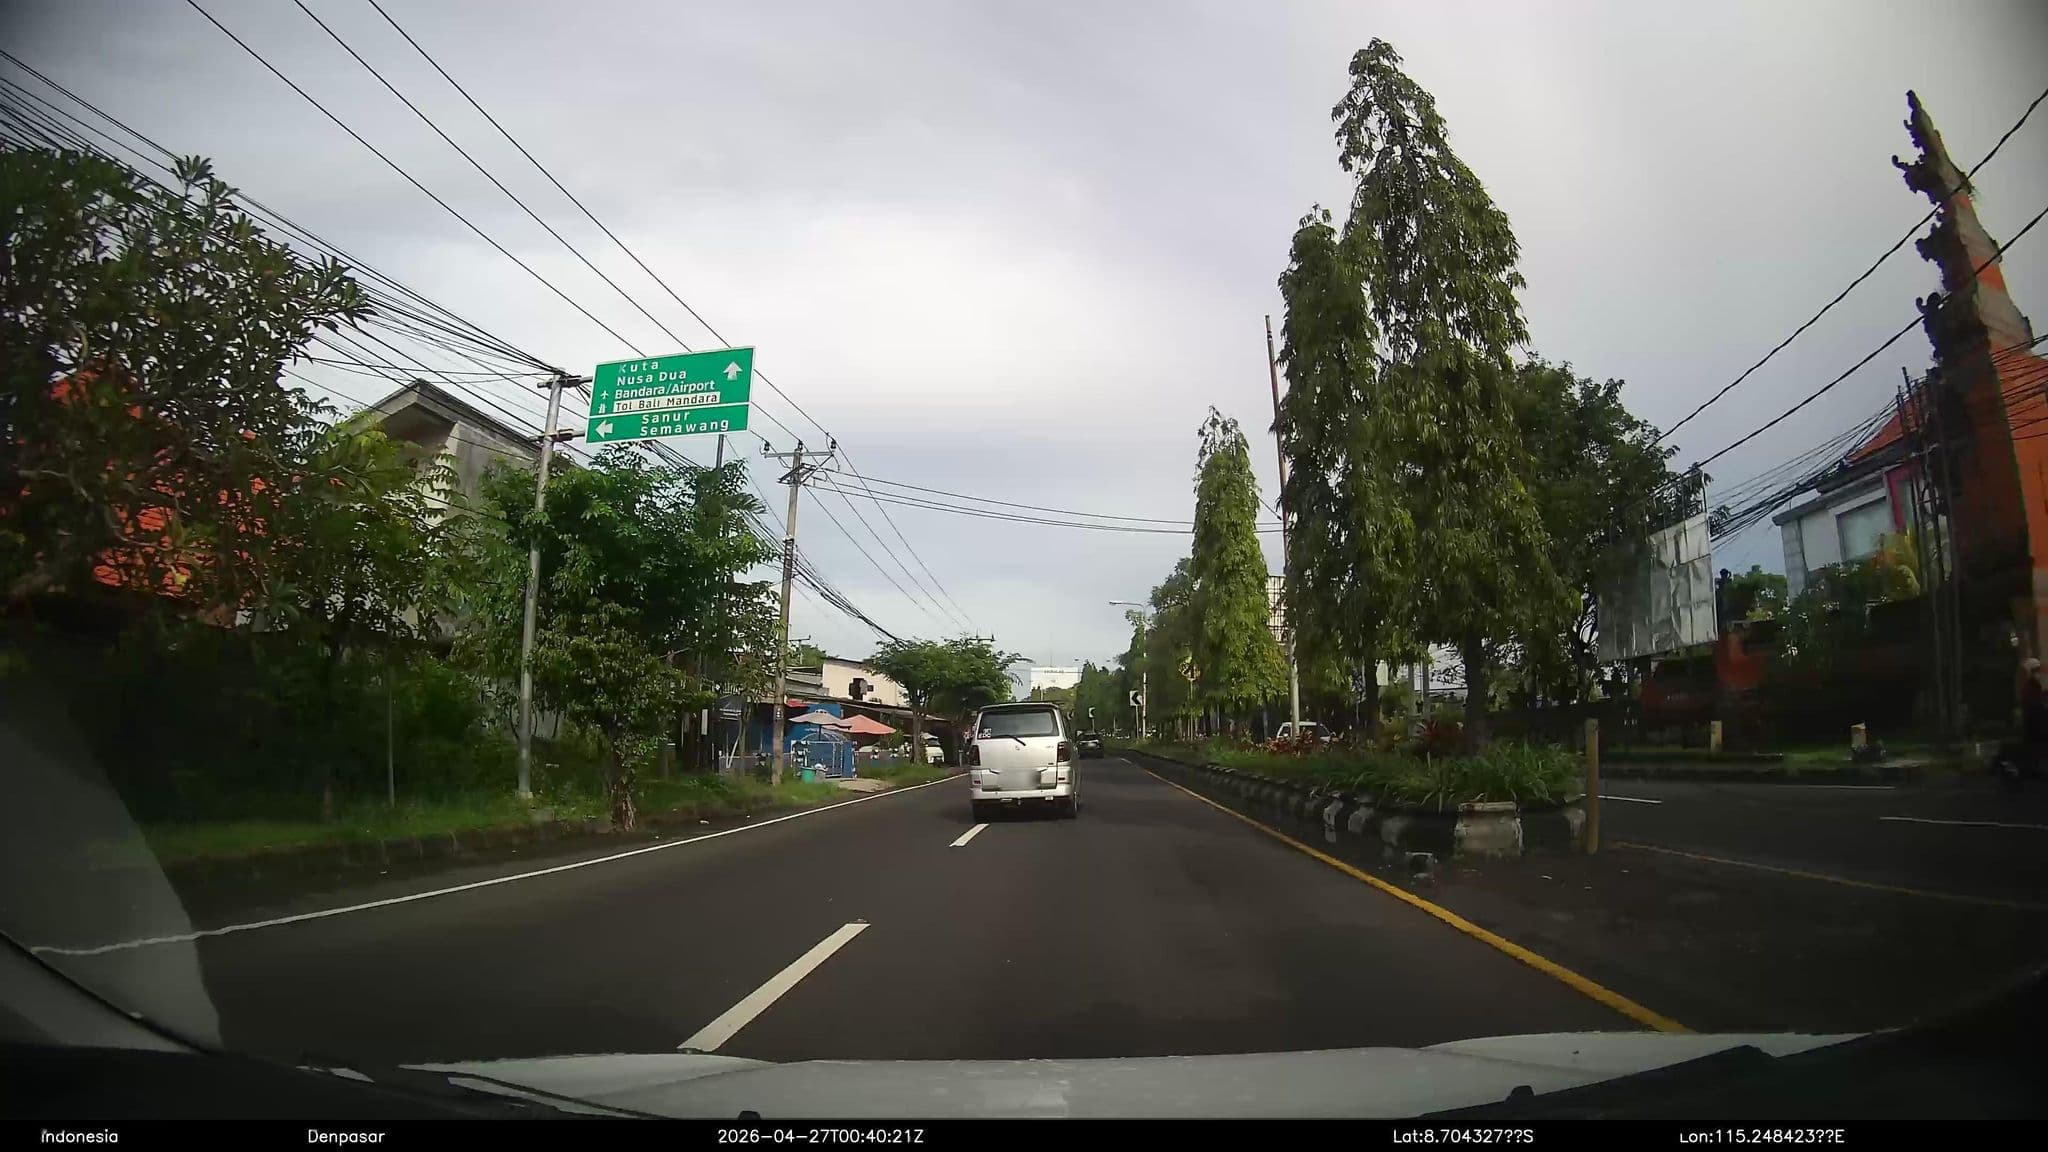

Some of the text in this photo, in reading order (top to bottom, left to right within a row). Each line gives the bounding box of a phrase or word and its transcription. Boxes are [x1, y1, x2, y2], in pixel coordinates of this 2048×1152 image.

[618, 361, 659, 374] Kuta
[617, 369, 687, 387] Nusa Dua
[615, 380, 716, 399] Bandara/Airport
[616, 393, 718, 412] Tol Bali Mandara
[642, 411, 691, 425] Sanur
[640, 420, 729, 437] Semawang
